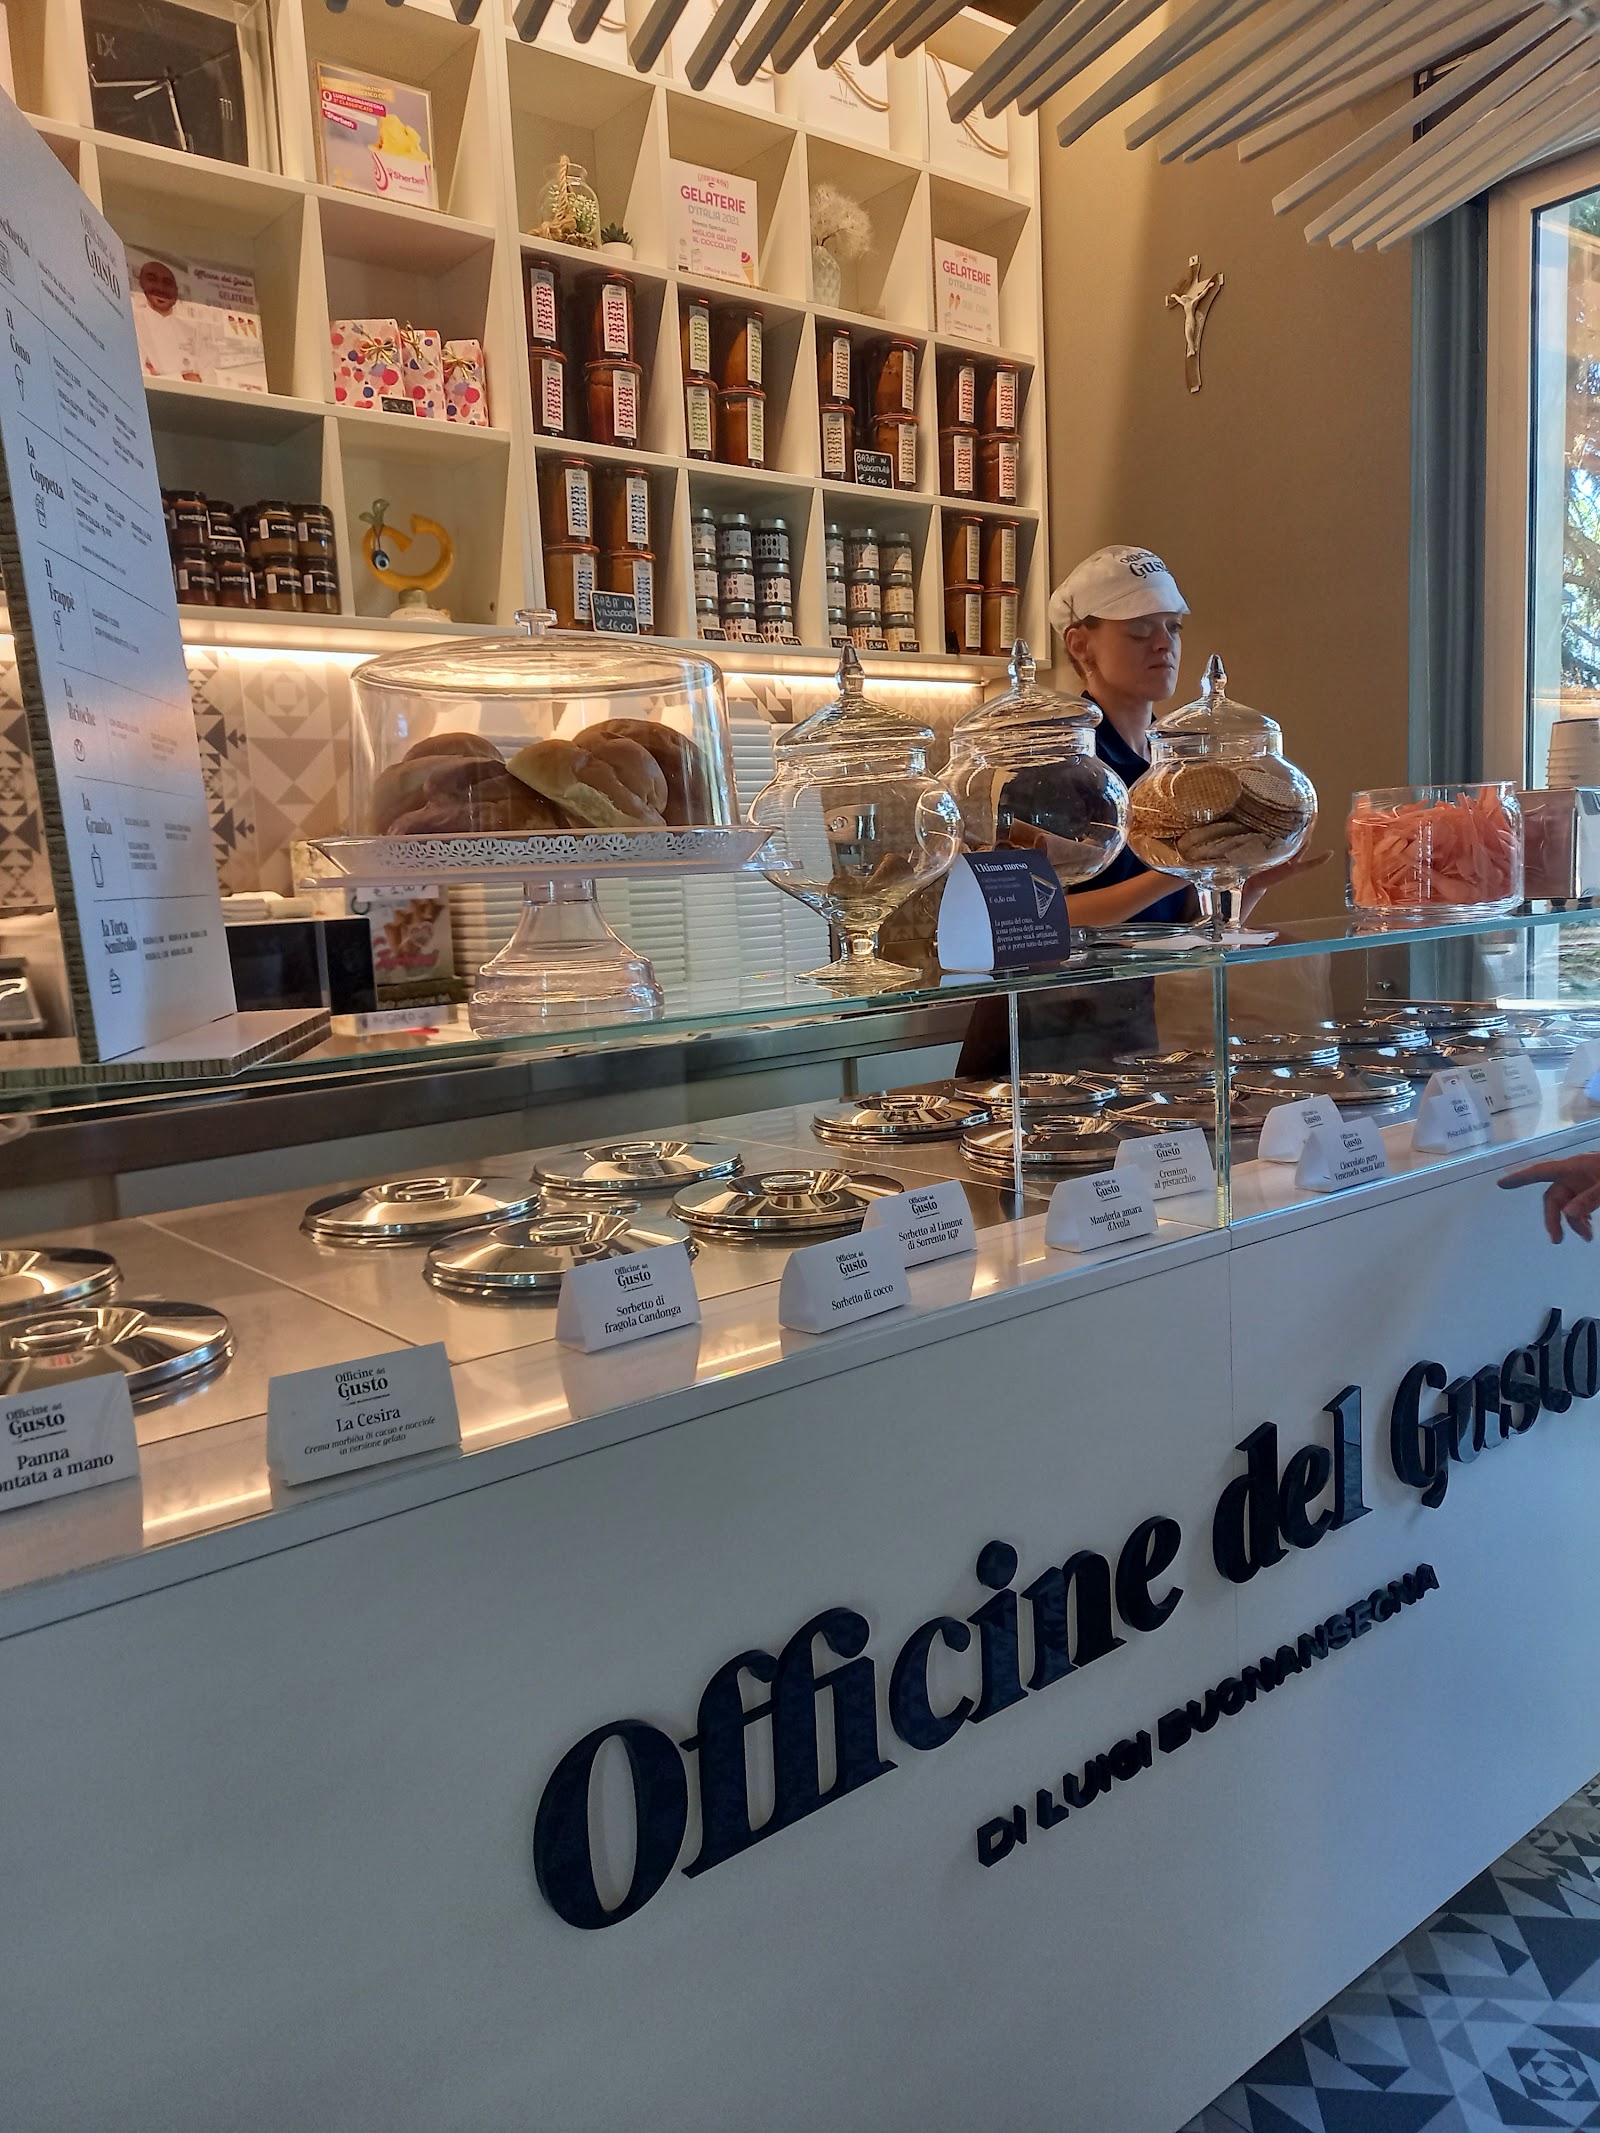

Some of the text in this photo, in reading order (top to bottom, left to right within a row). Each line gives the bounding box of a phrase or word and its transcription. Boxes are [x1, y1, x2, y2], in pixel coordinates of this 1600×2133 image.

[680, 185, 746, 214] GELATERIE
[688, 204, 740, 226] D'ITALIA 2021
[692, 228, 738, 245] MIGLIOR GELATO
[700, 238, 737, 252] CIOCCOLATO
[84, 233, 121, 300] Gusto
[942, 260, 991, 286] GELATERIE
[10, 333, 31, 366] Cono
[25, 436, 36, 460] la
[30, 462, 65, 500] Coppetta
[44, 558, 53, 578] il
[64, 678, 74, 698] la
[81, 792, 92, 812] la
[85, 816, 113, 835] Granita
[974, 862, 1028, 873] Ultimo morso
[100, 919, 129, 938] la Torta
[1156, 1146, 1181, 1160] Gusto
[1343, 1137, 1362, 1150] Gusto
[1334, 1166, 1360, 1180] Venezuela
[1360, 1164, 1374, 1174] senza
[1340, 1154, 1378, 1170] Cioccolato puro
[1154, 1174, 1196, 1190] al pistacchio
[1159, 1166, 1188, 1179] Cremino
[908, 1196, 929, 1205] Officine
[1096, 1184, 1120, 1198] Gusto
[911, 1200, 938, 1216] Gusto
[1090, 1204, 1143, 1226] Mandorla amara
[898, 1217, 964, 1242] Sorbetto al Limone
[1107, 1218, 1131, 1232] d'Avola
[907, 1228, 960, 1250] di Sorrento IGP
[836, 1252, 858, 1264] Officine
[839, 1258, 868, 1276] Gusto
[614, 1264, 641, 1276] Officine
[617, 1269, 652, 1290] Gusto
[616, 1294, 665, 1318] Sorbetto di
[831, 1284, 894, 1312] Sorbetto di cocco
[604, 1305, 682, 1334] fragola Candonga
[334, 1368, 374, 1384] Officine
[337, 1376, 388, 1402] Gusto
[6, 1404, 49, 1421] Officine
[336, 1408, 402, 1433] La Cesira
[8, 1412, 66, 1438] Gusto
[304, 1442, 331, 1456] Crema
[331, 1432, 364, 1450] morbida
[365, 1430, 374, 1440] di
[374, 1426, 398, 1438] cacao
[404, 1416, 436, 1432] nocciole
[338, 1432, 407, 1456] in versione gelato
[16, 1448, 70, 1470] Panna
[52, 1466, 63, 1479] a
[66, 1453, 115, 1477] mano
[533, 1306, 1600, 1930] Officine del Gusto
[976, 1562, 1441, 1868] DI LUIGI BUONANSEGNA
